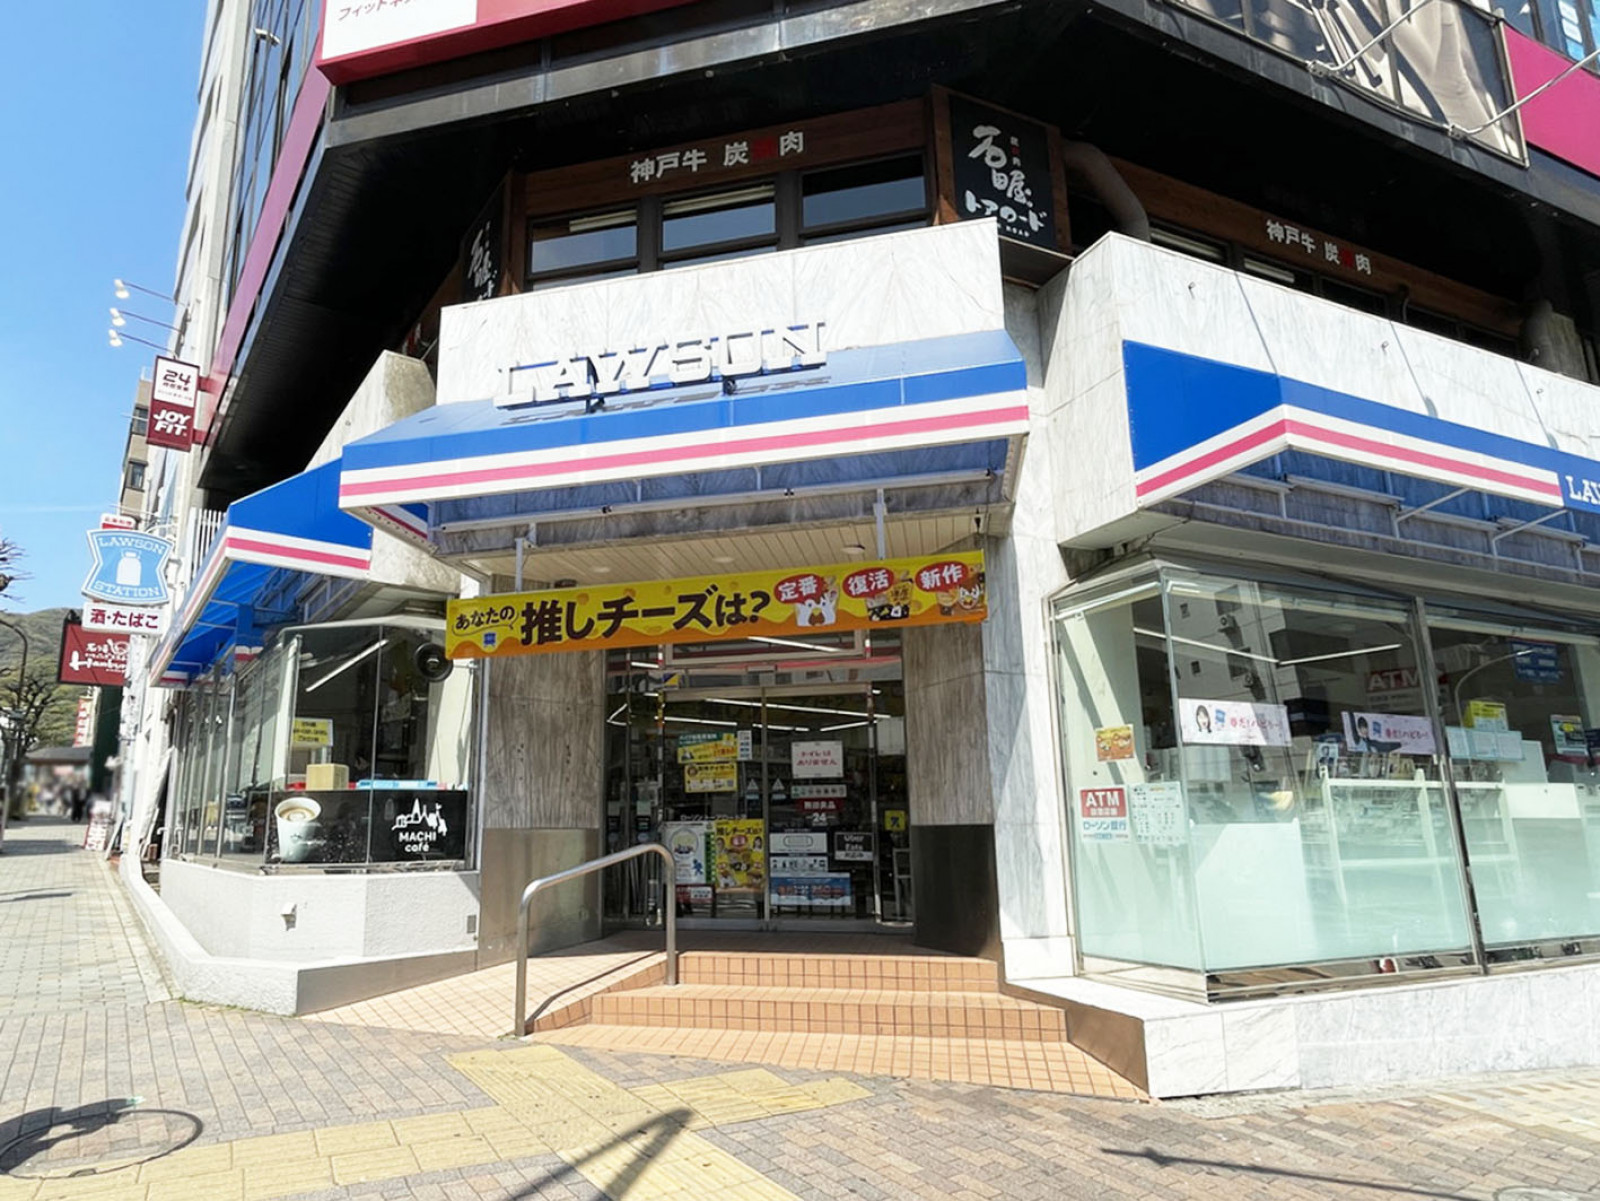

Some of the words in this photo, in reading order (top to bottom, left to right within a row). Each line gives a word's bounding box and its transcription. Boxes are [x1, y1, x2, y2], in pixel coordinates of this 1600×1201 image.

[630, 149, 707, 183] 神戸牛
[723, 131, 804, 167] 炭肉
[965, 190, 1047, 232] トアロード
[1266, 219, 1316, 253] 神戸牛
[1324, 241, 1371, 275] 炭肉
[493, 322, 827, 408] LAWSON
[163, 369, 191, 386] 24
[153, 409, 191, 425] JOY
[154, 420, 188, 436] FIT
[98, 536, 166, 555] LAWSON
[848, 569, 889, 596] 復活
[920, 563, 964, 589] 新作
[94, 580, 160, 597] STATION
[779, 575, 818, 602] 定番
[90, 608, 159, 629] 酒・たばこ
[456, 605, 515, 630] あなたの
[520, 590, 771, 646] 推しチーズは?
[1367, 670, 1419, 691] ATM
[1085, 790, 1121, 808] ATM
[398, 831, 437, 842] MACHI
[1083, 821, 1127, 831] ローソン銀行
